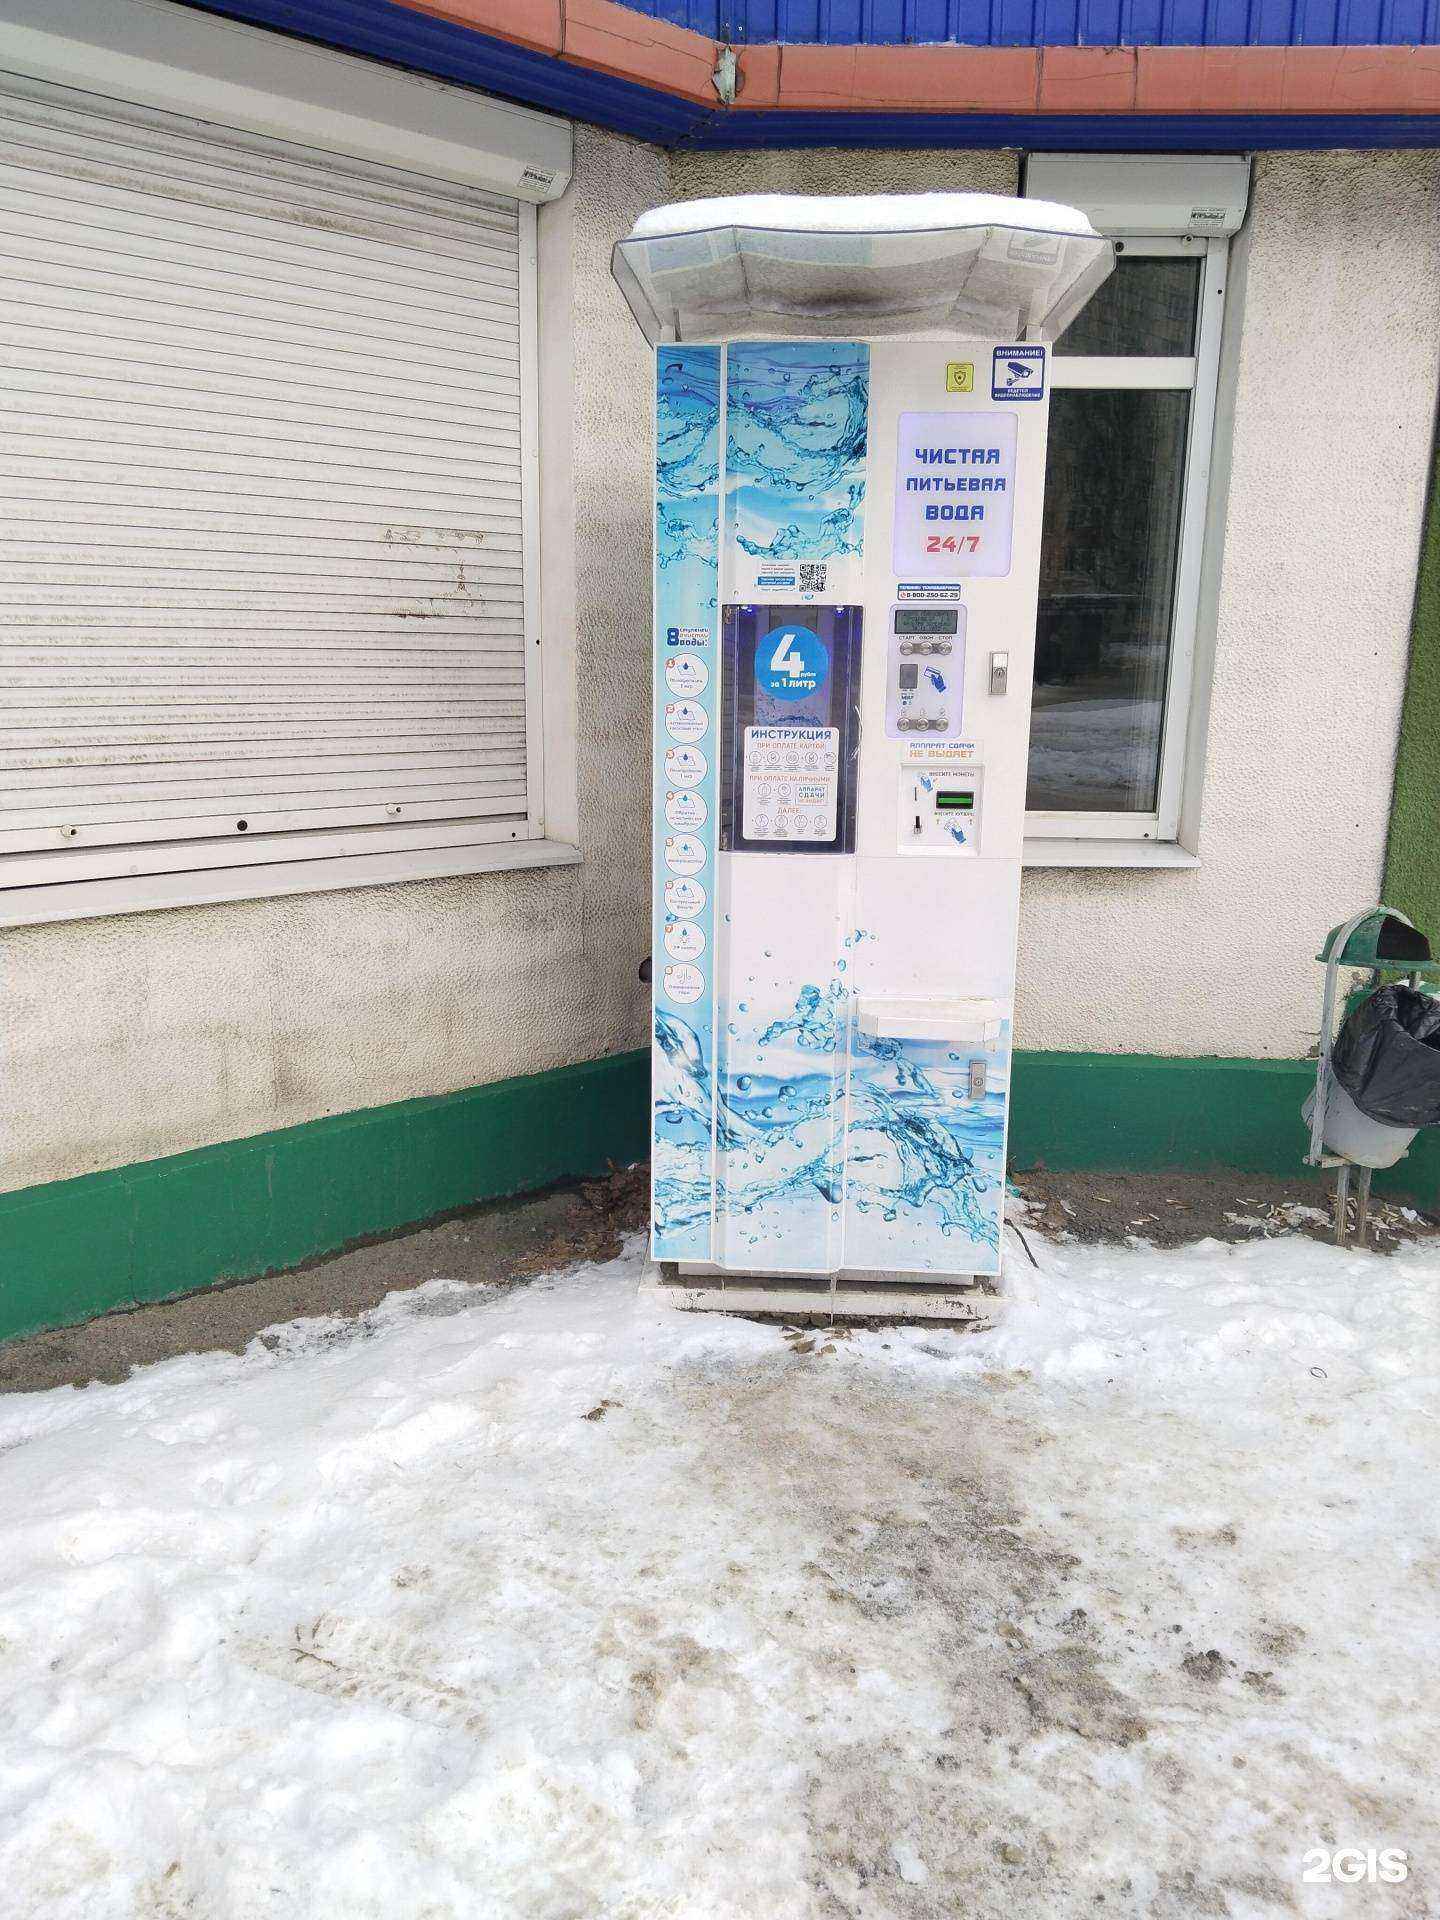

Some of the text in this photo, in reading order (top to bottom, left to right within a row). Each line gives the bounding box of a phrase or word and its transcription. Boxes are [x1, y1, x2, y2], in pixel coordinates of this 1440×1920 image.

[996, 349, 1043, 357] ВНИМАНИЕ!
[914, 448, 1000, 465] ЧИСТАЯ
[906, 477, 1006, 491] ПИТЬЕВАЯ
[925, 504, 984, 521] ВОДА
[926, 535, 980, 555] 24/7
[666, 627, 680, 646] 8
[770, 633, 805, 678] 4
[787, 680, 816, 690] литр
[751, 729, 832, 740] ИНСТРУКЦИЯ
[910, 750, 923, 758] НЕ
